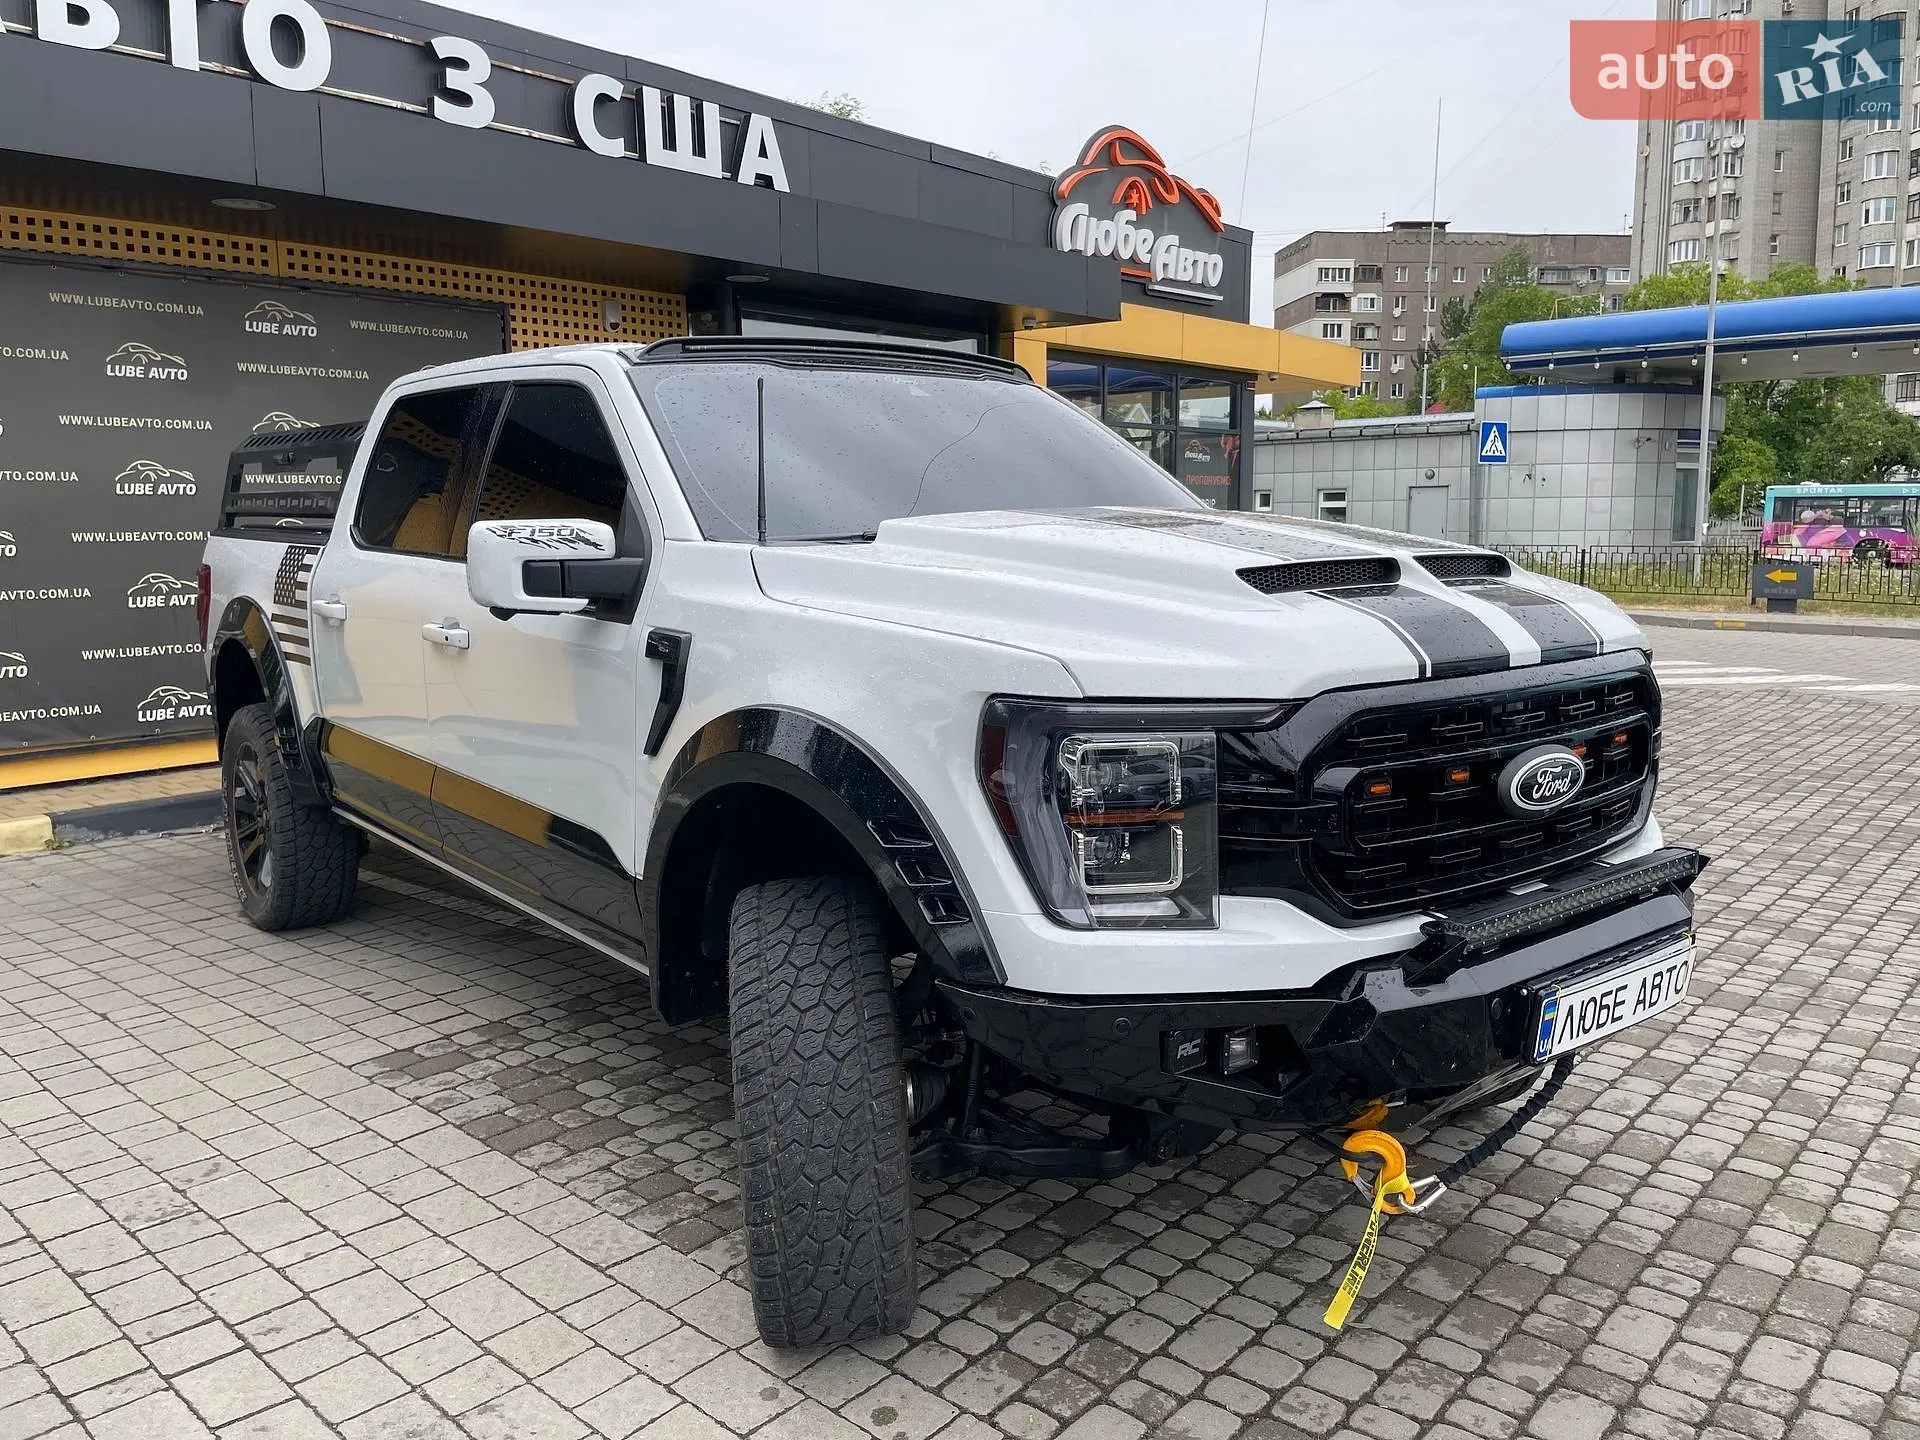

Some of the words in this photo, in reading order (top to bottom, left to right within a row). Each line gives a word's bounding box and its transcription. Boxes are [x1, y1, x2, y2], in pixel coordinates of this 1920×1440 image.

[572, 73, 790, 193] США
[1151, 234, 1224, 288] Авто
[49, 292, 204, 316] WWW.LUBEAVTO.COM.UA
[245, 320, 279, 335] LUBE
[282, 322, 318, 338] AVTO
[349, 319, 469, 340] WWW.LUBEAVTO.COM.UA
[106, 363, 145, 378] LUBE
[148, 366, 188, 381] AVTO
[237, 362, 370, 381] WWW.LUBEAVTO.COM.UA
[59, 415, 213, 431] WWW.LUBEAVTO.COM.UA
[115, 483, 154, 496] LUBE
[157, 484, 197, 496] AVTO
[128, 596, 166, 609] LUBE
[137, 709, 175, 722] LUBE
[1533, 766, 1571, 799] Ford
[1558, 984, 1629, 1045] ЛЮБЕ
[1633, 960, 1689, 1016] АВТО
[1177, 1038, 1202, 1060] RC
